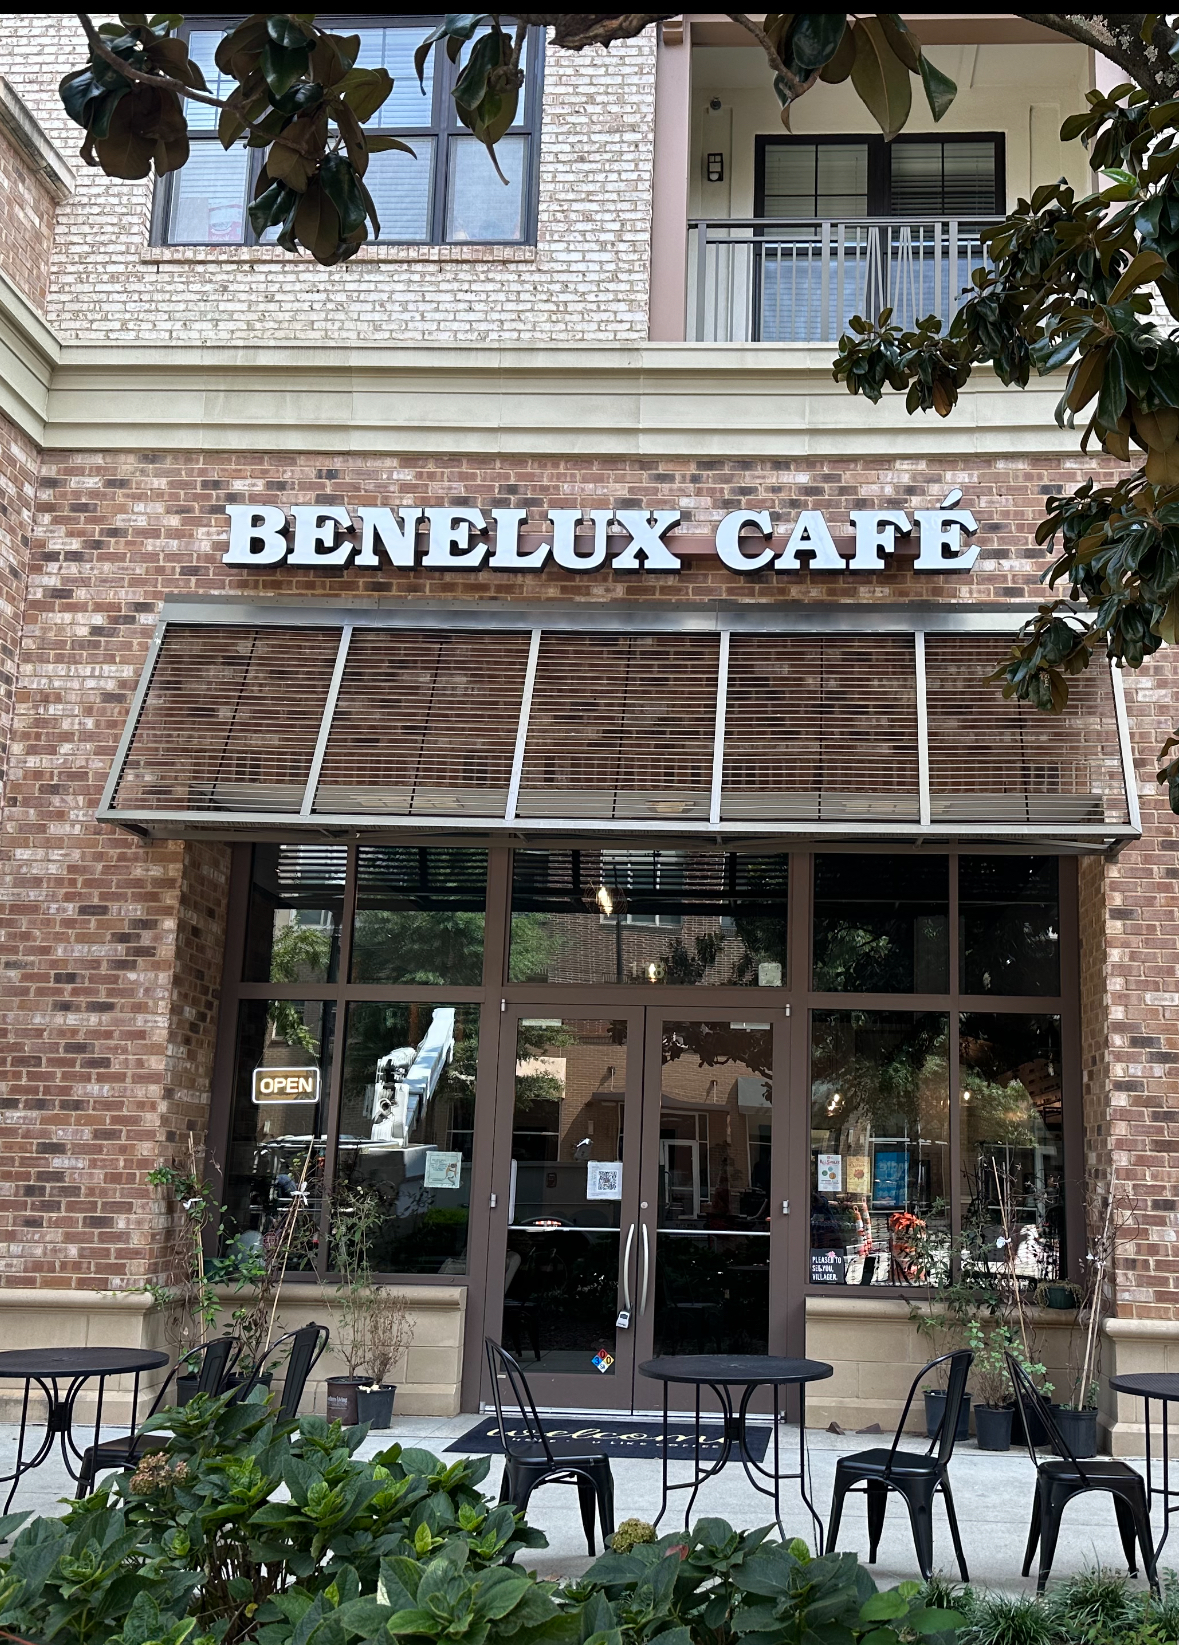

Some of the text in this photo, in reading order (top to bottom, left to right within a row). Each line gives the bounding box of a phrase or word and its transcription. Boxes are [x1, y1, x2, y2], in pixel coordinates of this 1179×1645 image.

[222, 488, 982, 575] BENELUX CAFÉ
[260, 1077, 313, 1093] OPEN
[595, 1356, 600, 1364] 3
[600, 1350, 605, 1358] 0
